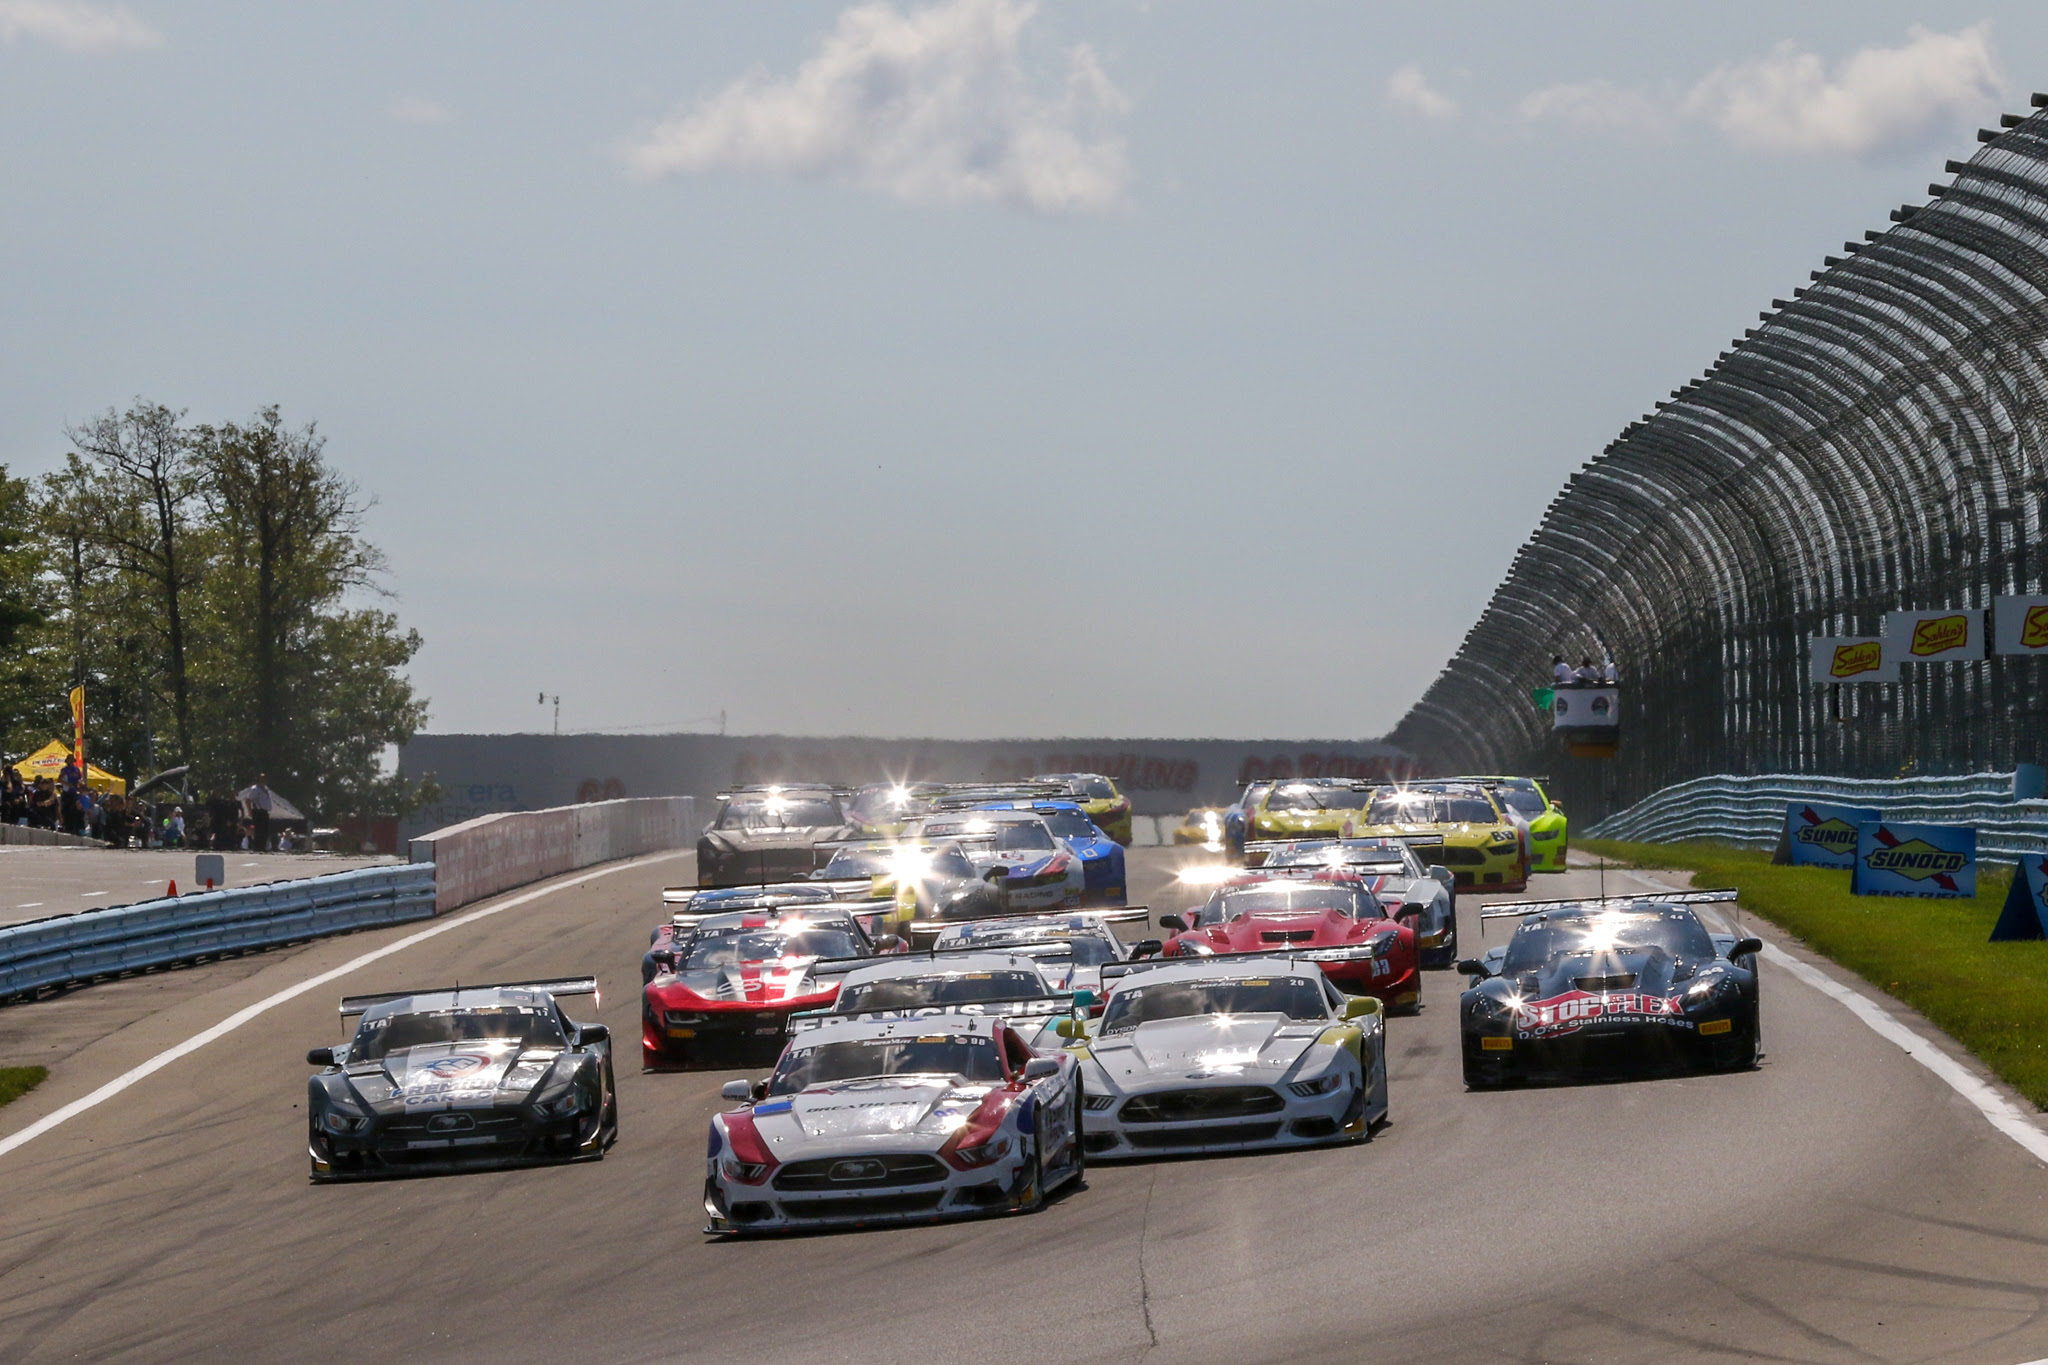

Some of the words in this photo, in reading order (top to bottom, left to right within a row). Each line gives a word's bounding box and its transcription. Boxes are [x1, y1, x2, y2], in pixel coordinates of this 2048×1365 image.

[1801, 828, 1858, 844] SUNOC
[1873, 852, 1961, 870] SUNOCO
[704, 930, 720, 938] TA
[1011, 973, 1025, 981] 21
[853, 985, 873, 996] TA
[1123, 990, 1143, 1001] TA
[1608, 994, 1684, 1016] FLEX
[368, 1020, 388, 1030] TA
[1568, 1016, 1641, 1028] Stainless
[1645, 1016, 1695, 1030] Hoses
[793, 1049, 811, 1059] TA
[405, 1090, 494, 1106] CARGO
